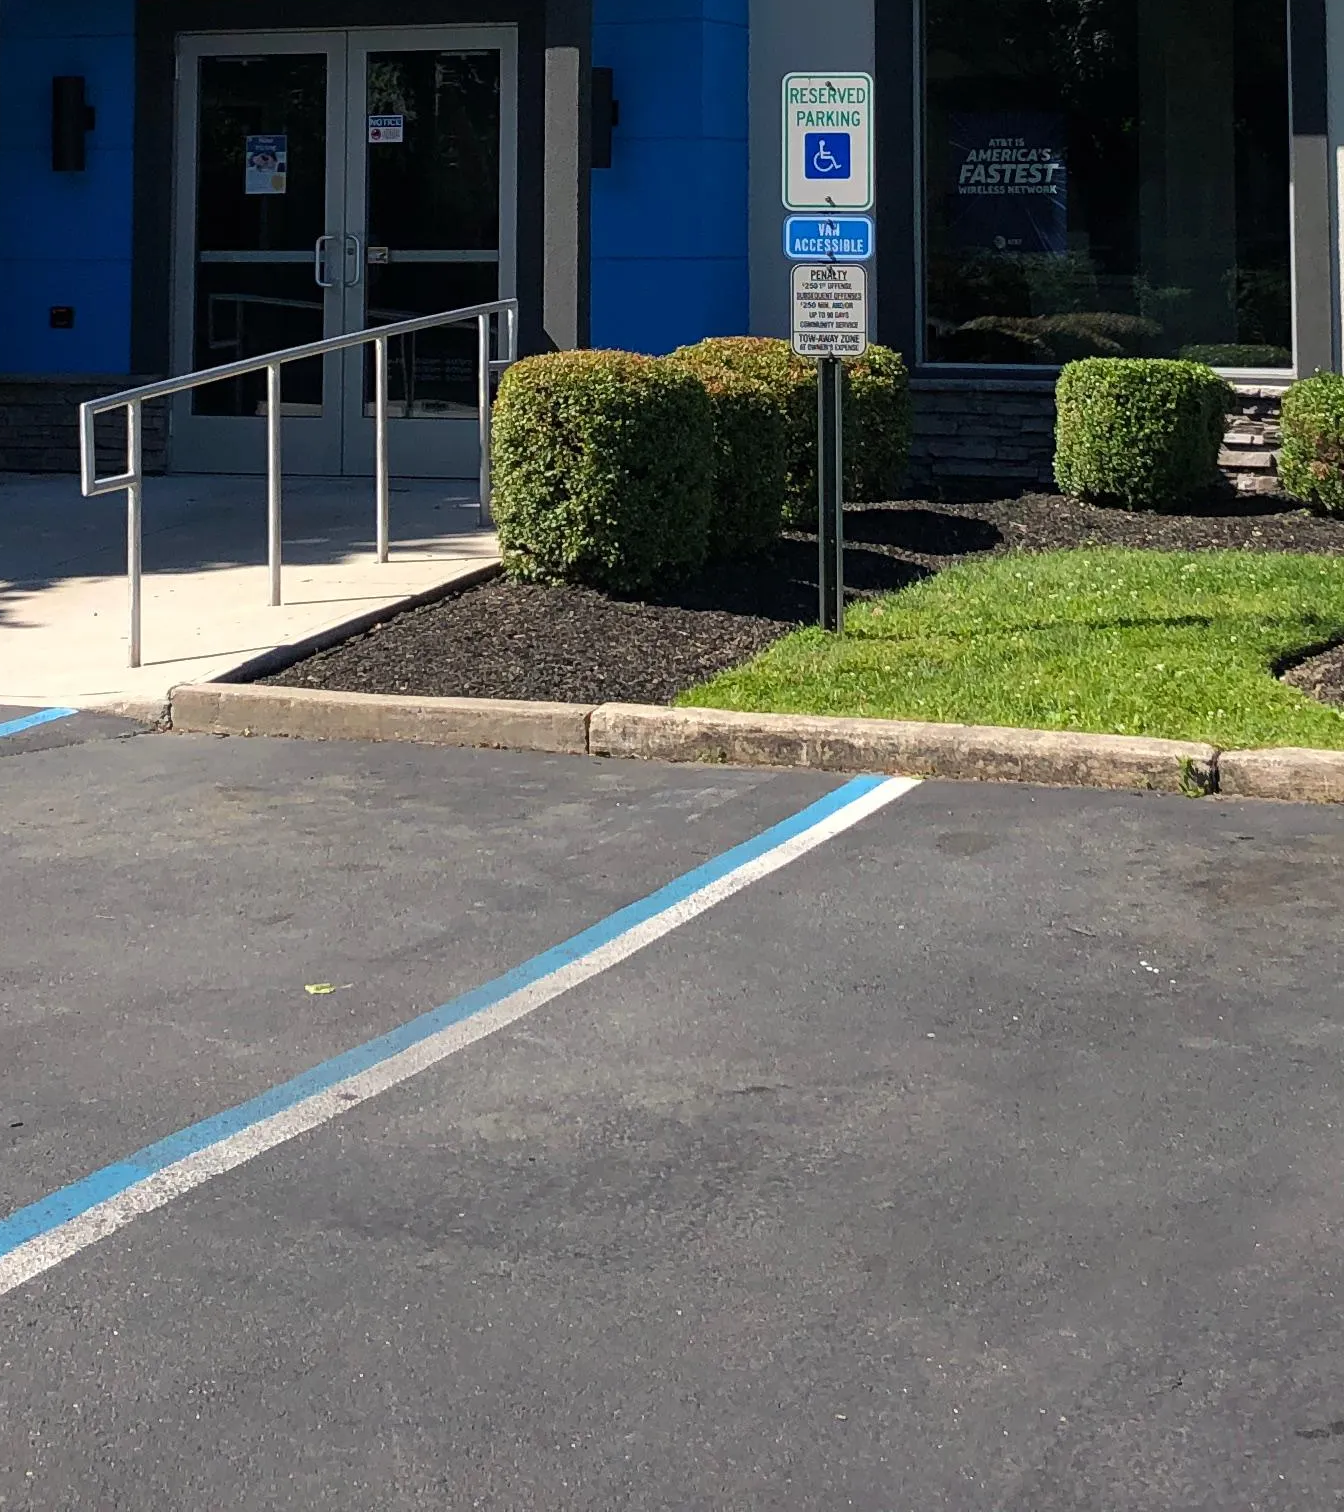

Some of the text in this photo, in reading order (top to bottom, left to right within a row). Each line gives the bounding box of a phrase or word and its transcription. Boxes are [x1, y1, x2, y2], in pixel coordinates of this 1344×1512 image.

[790, 88, 865, 104] RESERVED
[796, 111, 861, 127] PARKING
[966, 148, 1052, 162] AMERICA'S
[959, 163, 1059, 184] FASTEST
[958, 185, 1057, 194] WIRELESS NETWORK
[818, 223, 840, 237] VAN
[794, 238, 864, 253] ACCESSIBLE
[811, 270, 847, 280] PENALTY
[799, 334, 860, 343] TOW-AWAY ZONE
